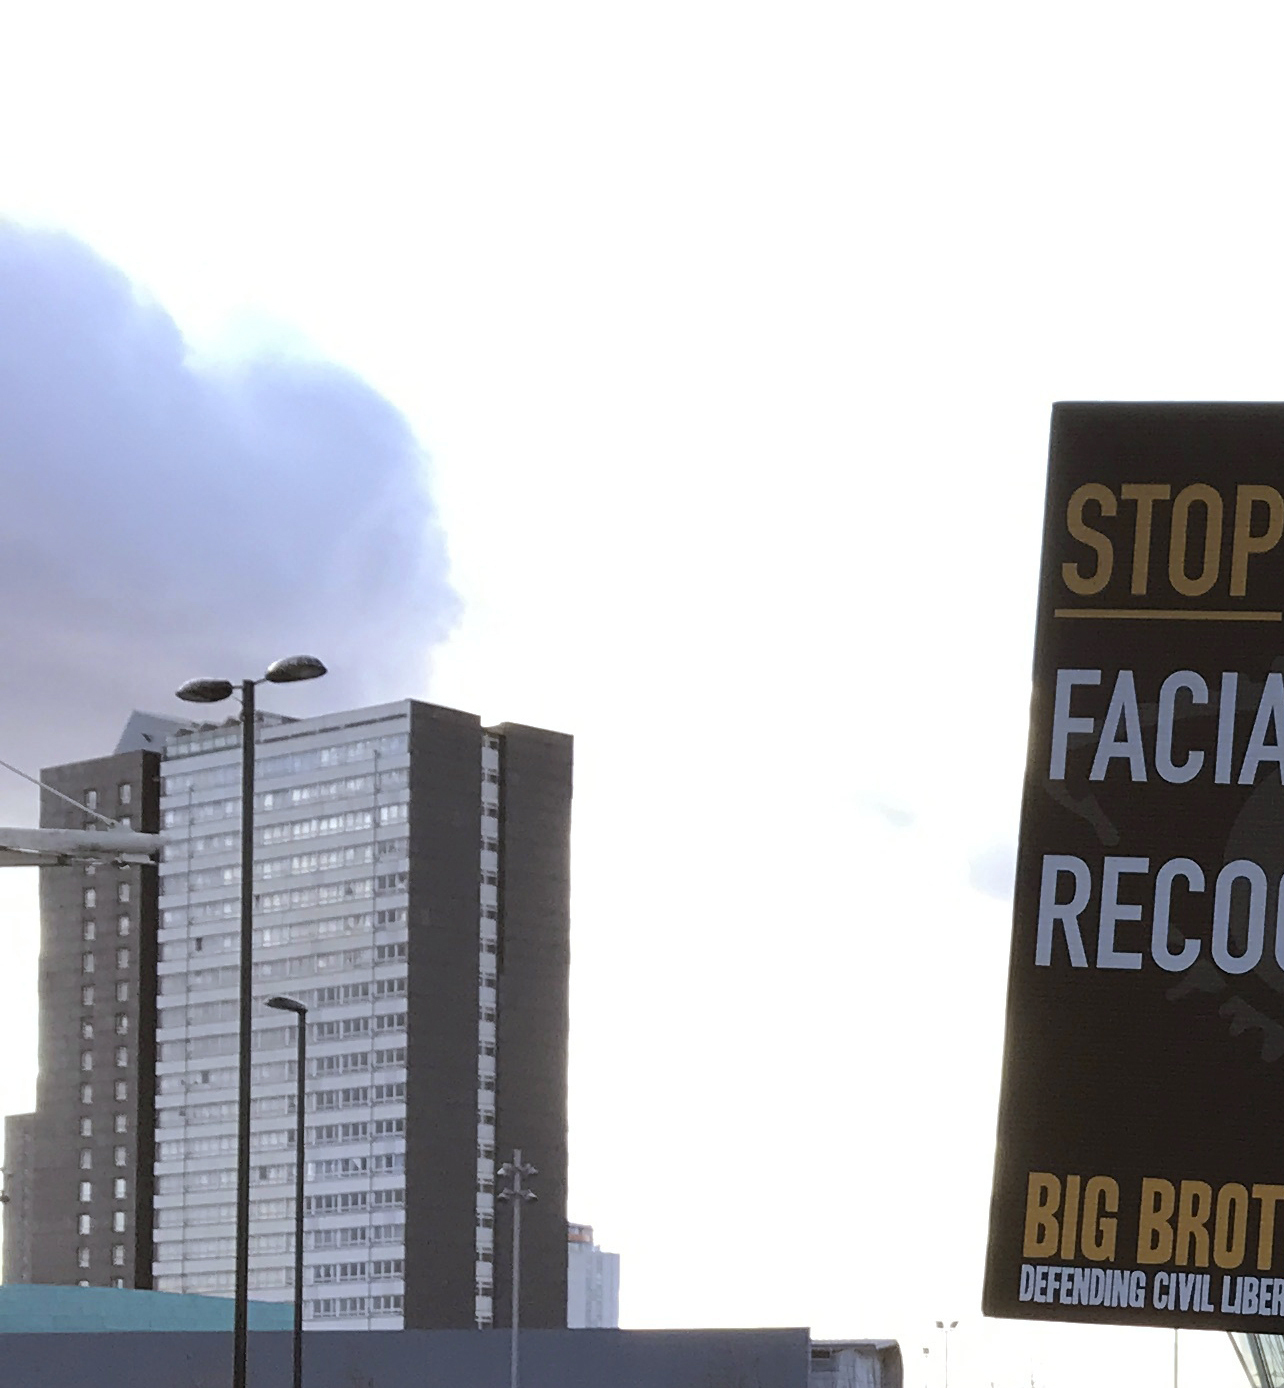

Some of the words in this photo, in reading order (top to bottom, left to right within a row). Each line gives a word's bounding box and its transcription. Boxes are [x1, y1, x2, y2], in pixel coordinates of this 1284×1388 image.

[1063, 484, 1284, 596] STOP
[1023, 1172, 1119, 1260] BIG
[1018, 1263, 1146, 1309] DEFENDING
[1152, 1272, 1215, 1315] CIVIL
